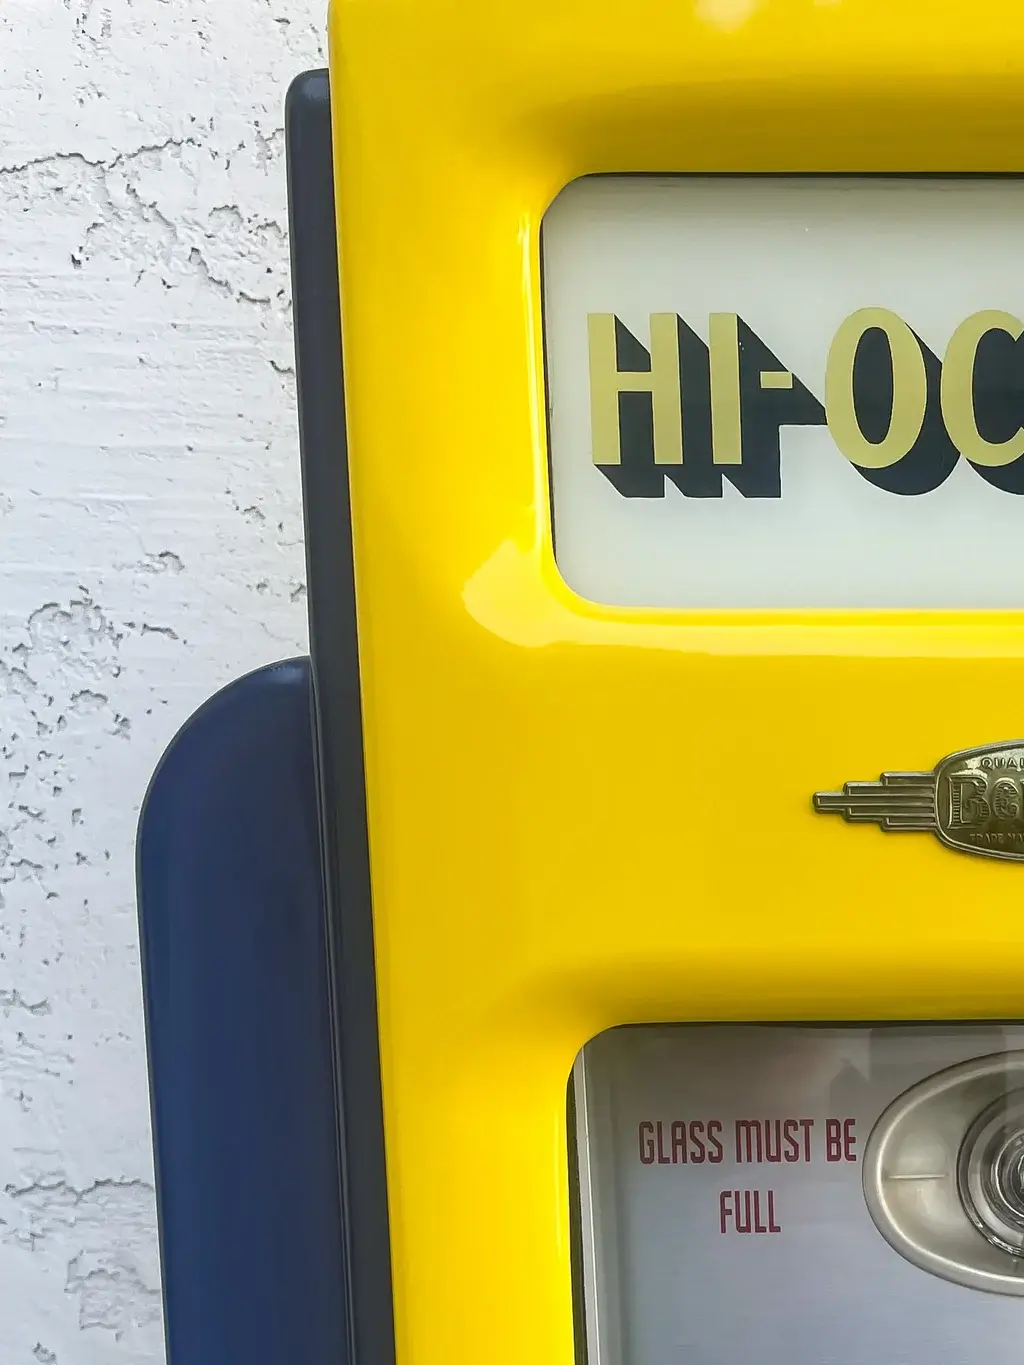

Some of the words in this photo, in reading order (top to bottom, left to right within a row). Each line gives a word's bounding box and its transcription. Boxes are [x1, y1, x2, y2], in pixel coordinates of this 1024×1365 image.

[638, 1119, 724, 1165] GLASS
[734, 1118, 815, 1164] MUST
[825, 1118, 857, 1162] BE
[719, 1190, 782, 1234] FULL
